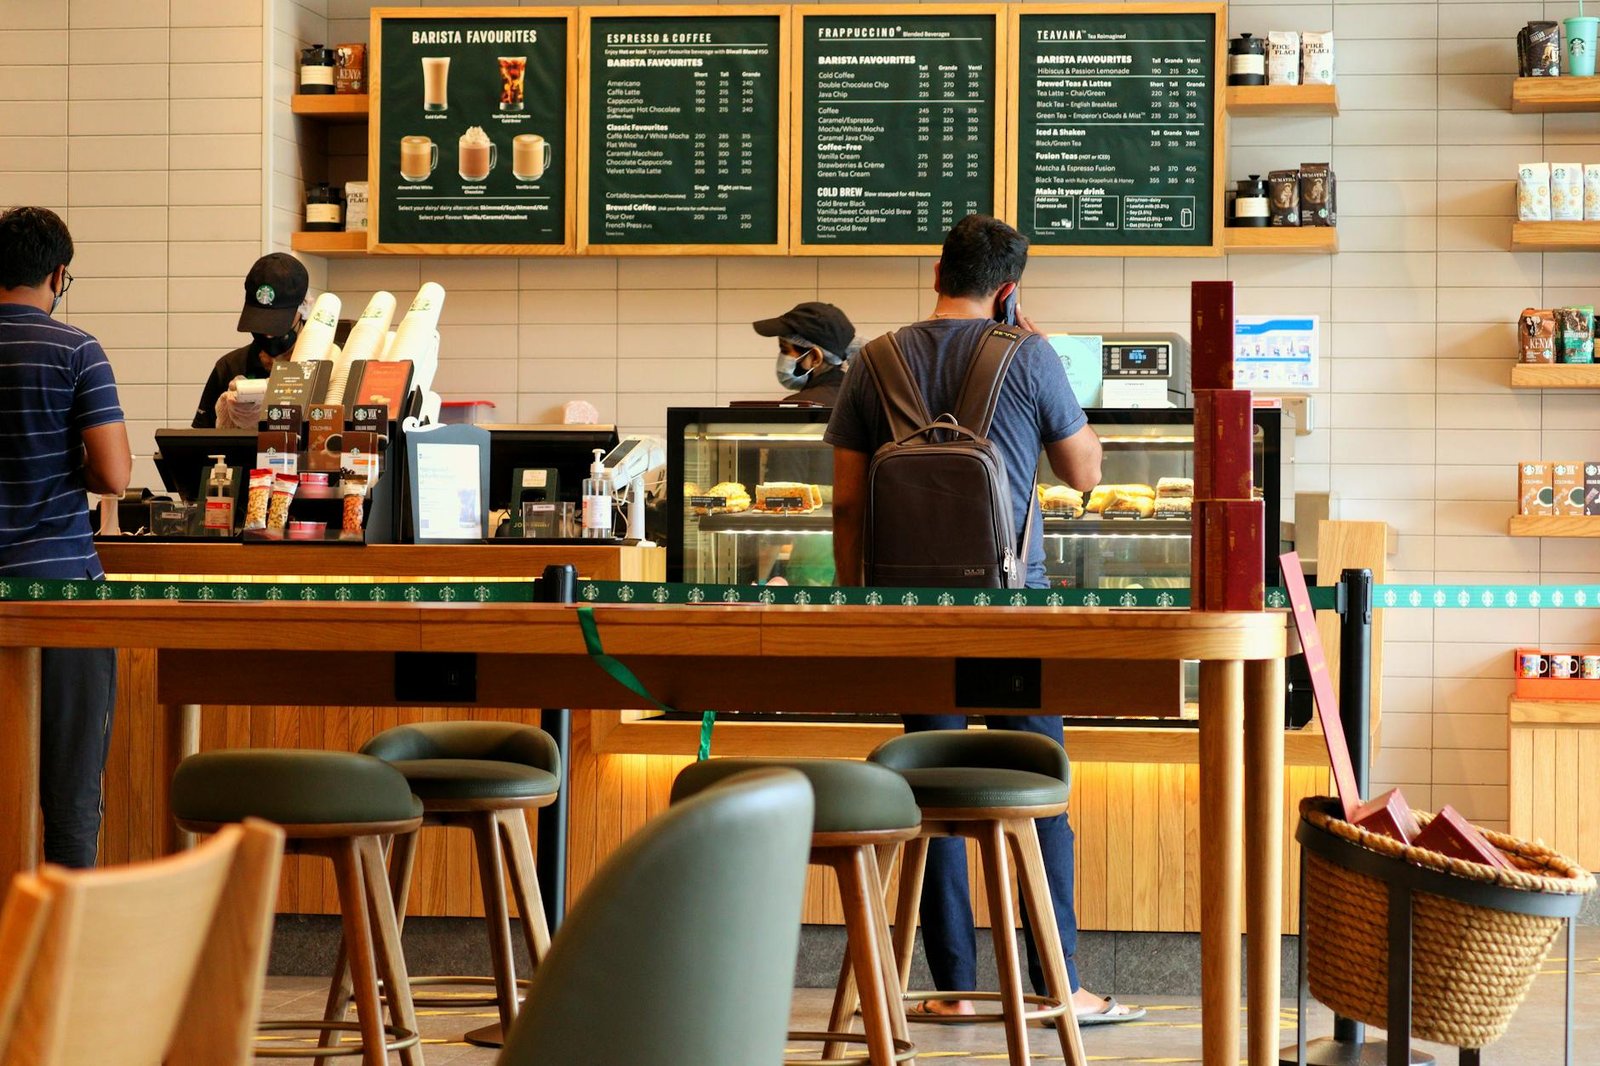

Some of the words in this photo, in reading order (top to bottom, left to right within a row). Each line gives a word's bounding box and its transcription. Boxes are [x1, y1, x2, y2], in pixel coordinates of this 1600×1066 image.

[412, 31, 461, 44] BARISTA
[467, 30, 537, 43] FAVOURITES
[607, 33, 659, 43] ESPRESSO
[663, 33, 669, 43] &
[672, 33, 712, 43] COFFEE
[340, 68, 361, 80] KENYA
[817, 188, 838, 197] COLD
[840, 188, 863, 197] BREW
[1530, 338, 1553, 349] KENYA
